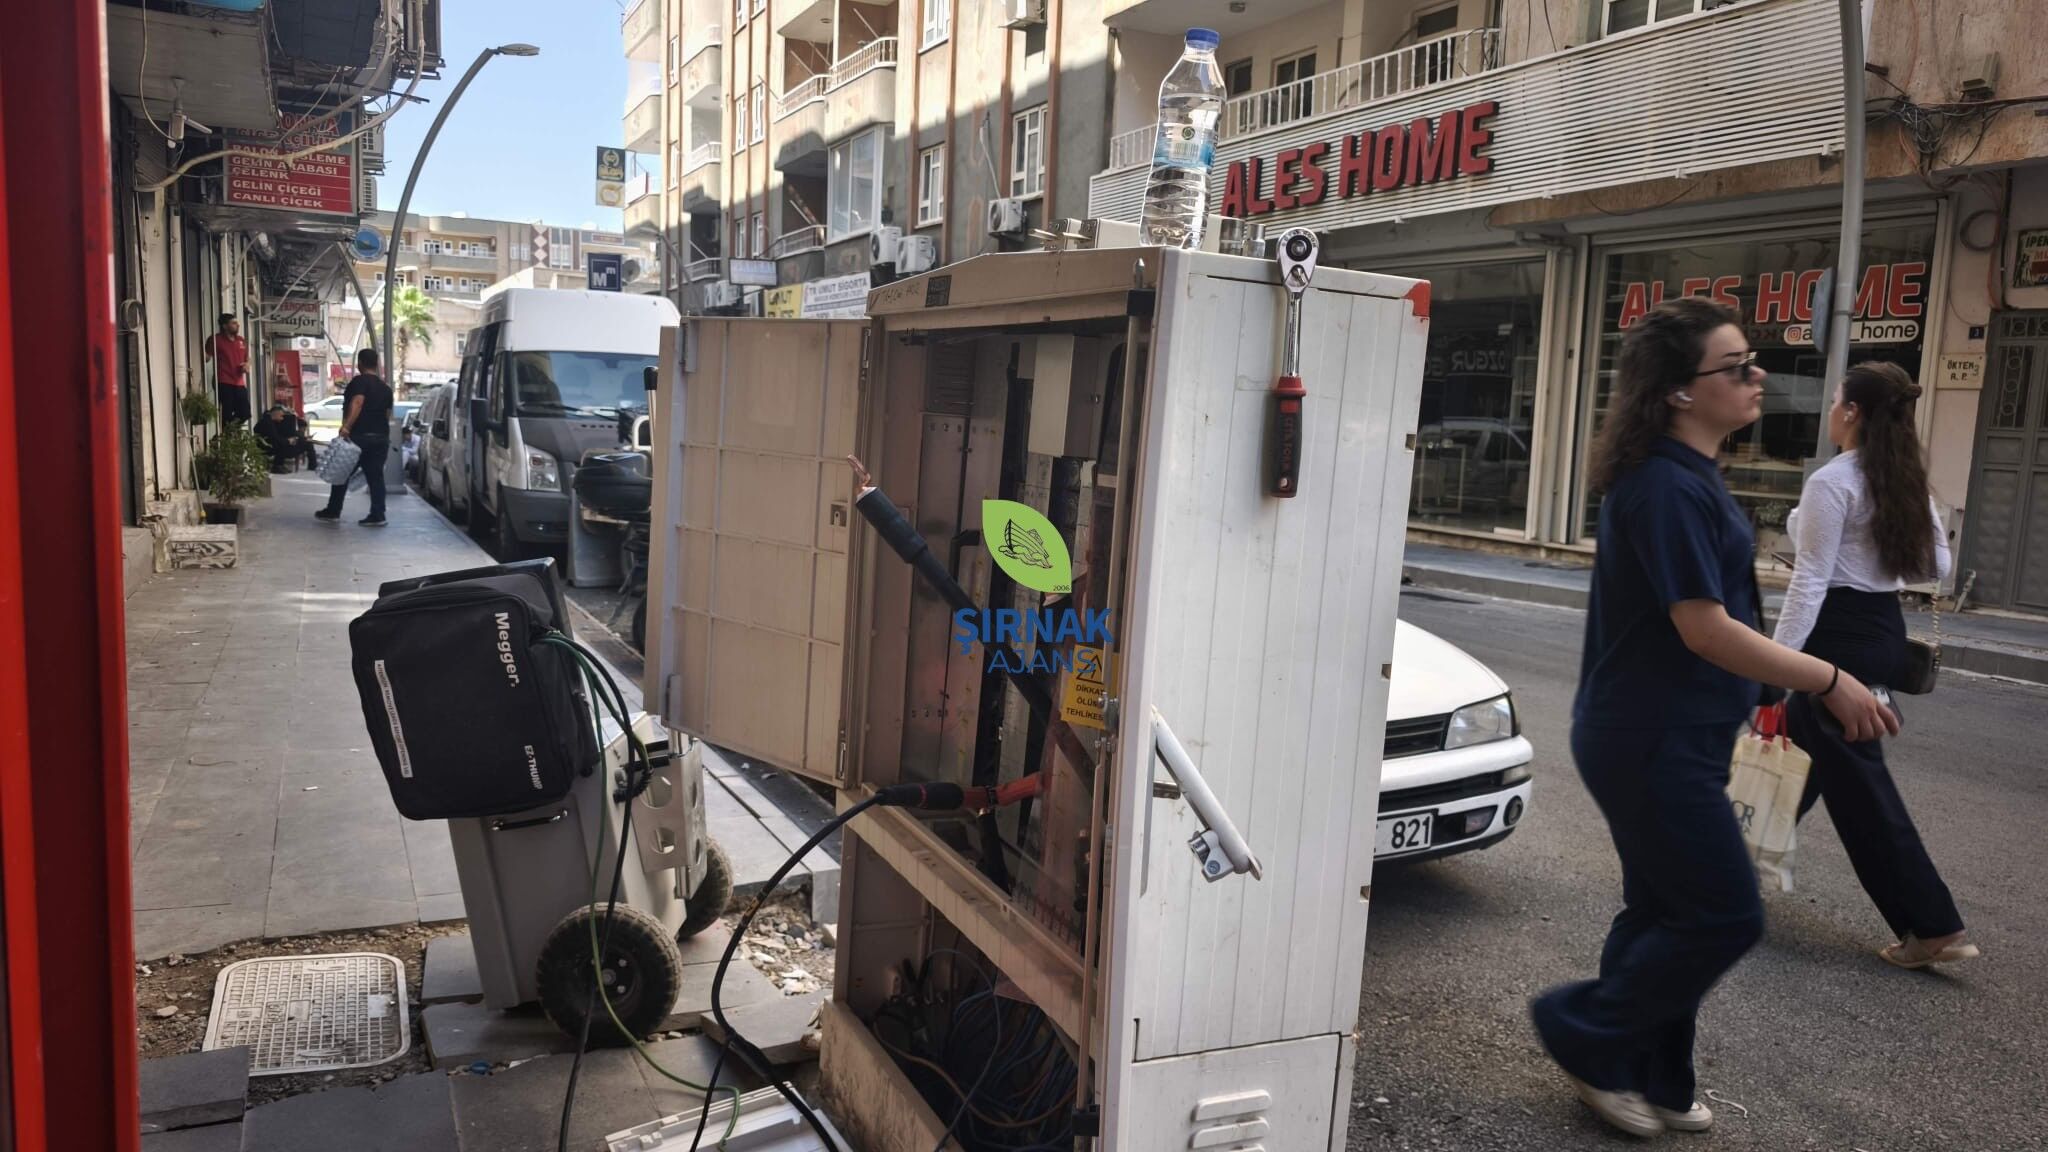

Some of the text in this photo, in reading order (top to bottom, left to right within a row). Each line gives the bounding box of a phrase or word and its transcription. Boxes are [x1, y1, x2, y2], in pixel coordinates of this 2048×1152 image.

[1220, 142, 1330, 217] ALES
[1338, 100, 1499, 199] HOME
[232, 166, 290, 180] ÇELENK
[232, 179, 321, 197] GELİN ÇİÇEĞİ
[232, 192, 323, 208] CANLI ÇİÇEK
[1066, 707, 1104, 720] TEHLİKES
[1391, 816, 1431, 850] 821
